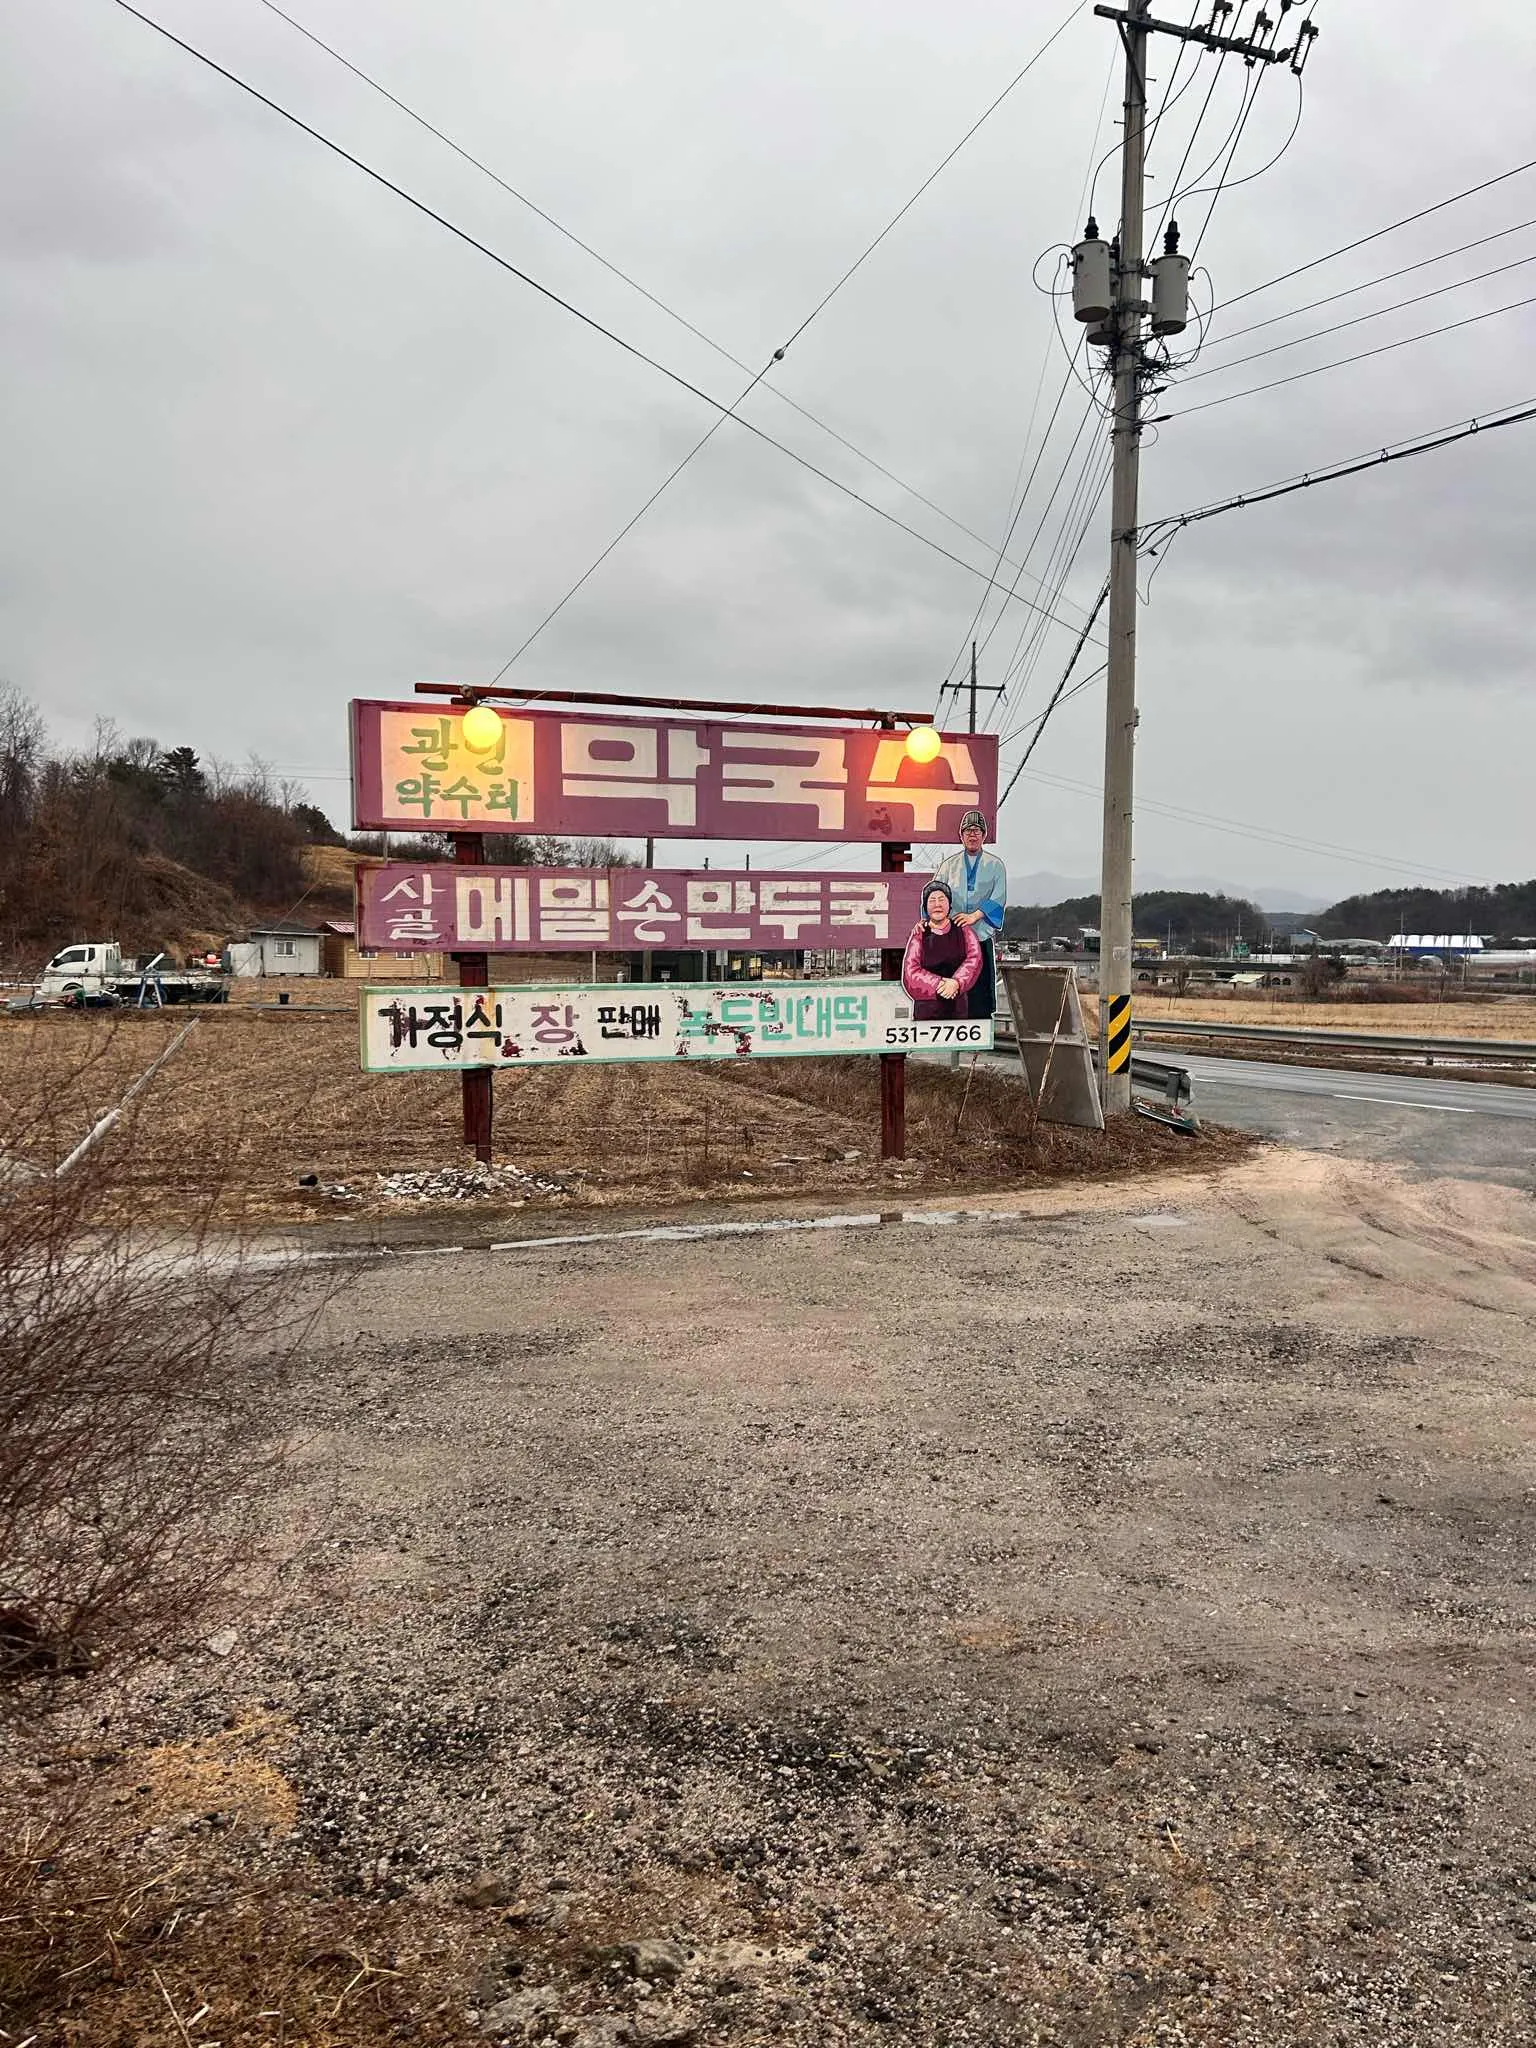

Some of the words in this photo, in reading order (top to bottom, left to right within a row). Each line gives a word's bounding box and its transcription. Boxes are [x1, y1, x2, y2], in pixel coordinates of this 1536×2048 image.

[395, 772, 519, 821] 약수터
[561, 723, 982, 832] 막국수
[380, 874, 447, 941] 사골
[377, 1003, 503, 1049] 가정식
[530, 1004, 580, 1044] 장
[597, 1004, 661, 1038] 판매
[885, 1024, 982, 1044] 531-7766
